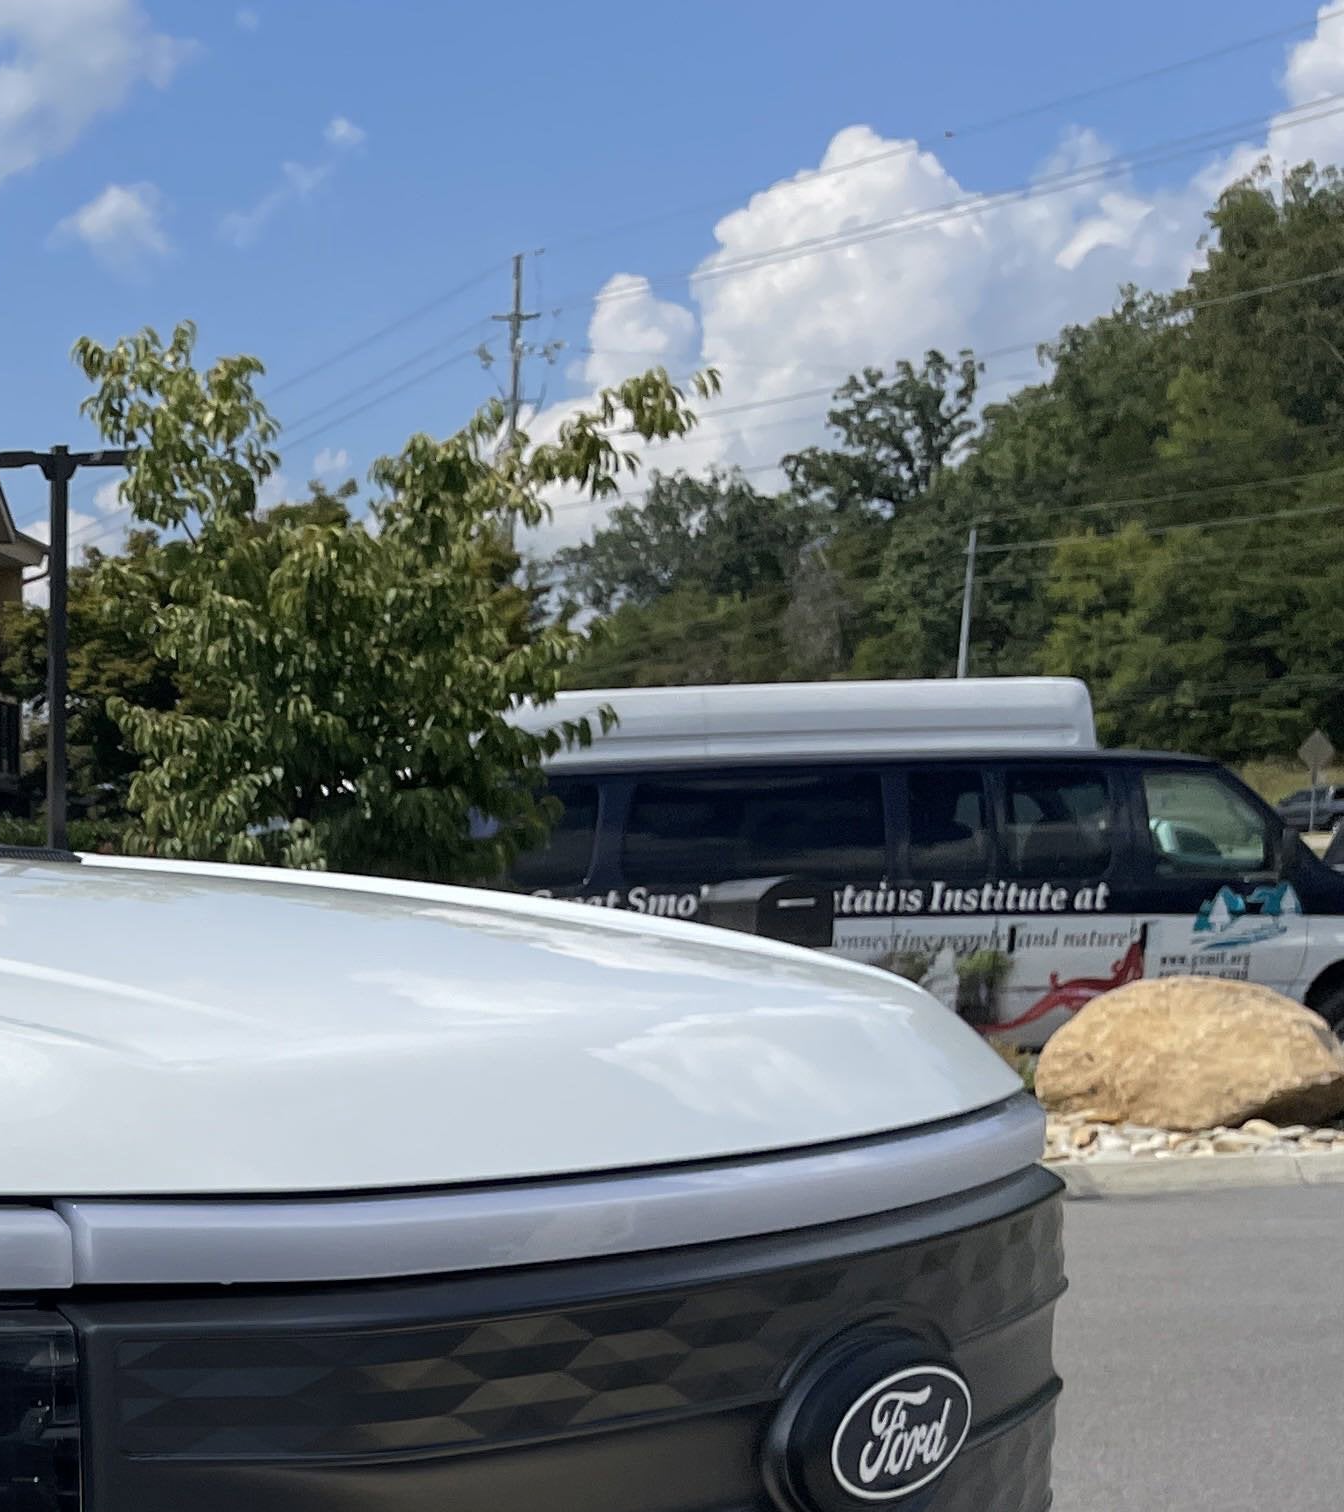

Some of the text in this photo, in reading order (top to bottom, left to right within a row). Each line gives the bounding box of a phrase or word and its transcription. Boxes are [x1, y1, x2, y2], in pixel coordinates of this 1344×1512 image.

[628, 885, 709, 917] Smo
[930, 881, 1067, 912] Institute
[1074, 881, 1109, 911] at
[860, 1385, 953, 1483] Ford
